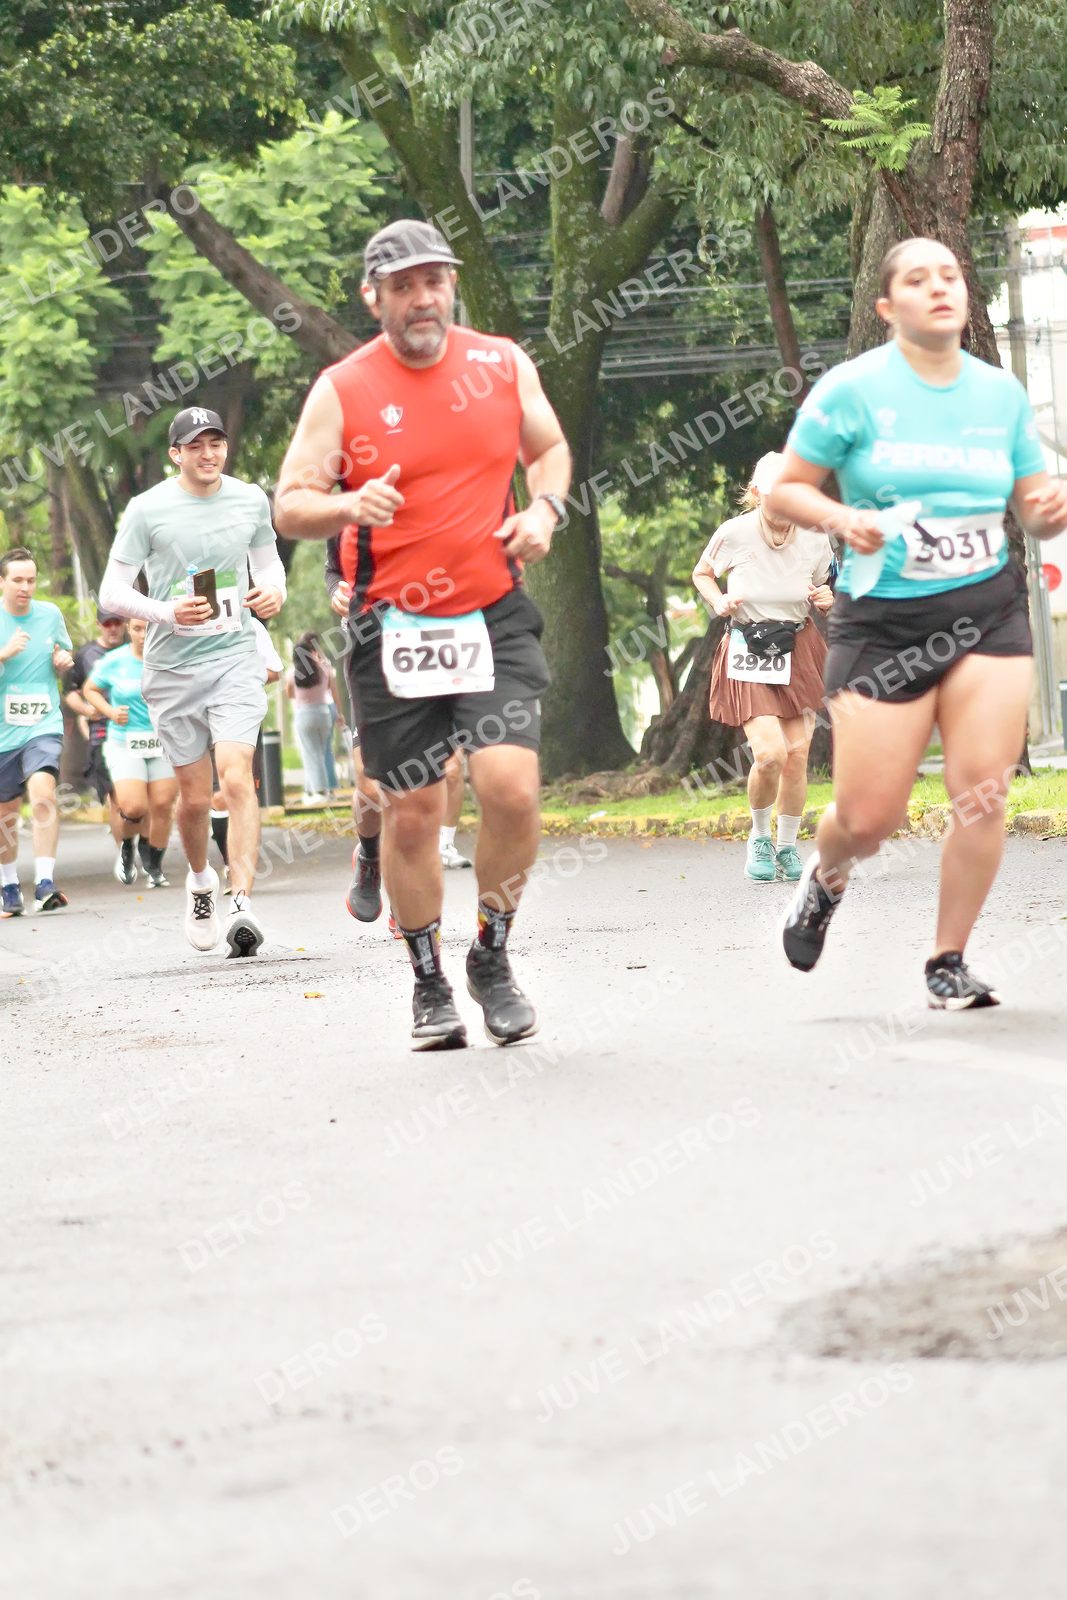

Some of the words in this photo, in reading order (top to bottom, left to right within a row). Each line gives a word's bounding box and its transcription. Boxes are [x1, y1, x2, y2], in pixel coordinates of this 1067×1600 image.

[467, 349, 502, 363] FILA
[392, 642, 481, 673] 6207
[732, 654, 786, 672] 2920
[9, 702, 49, 715] 5872
